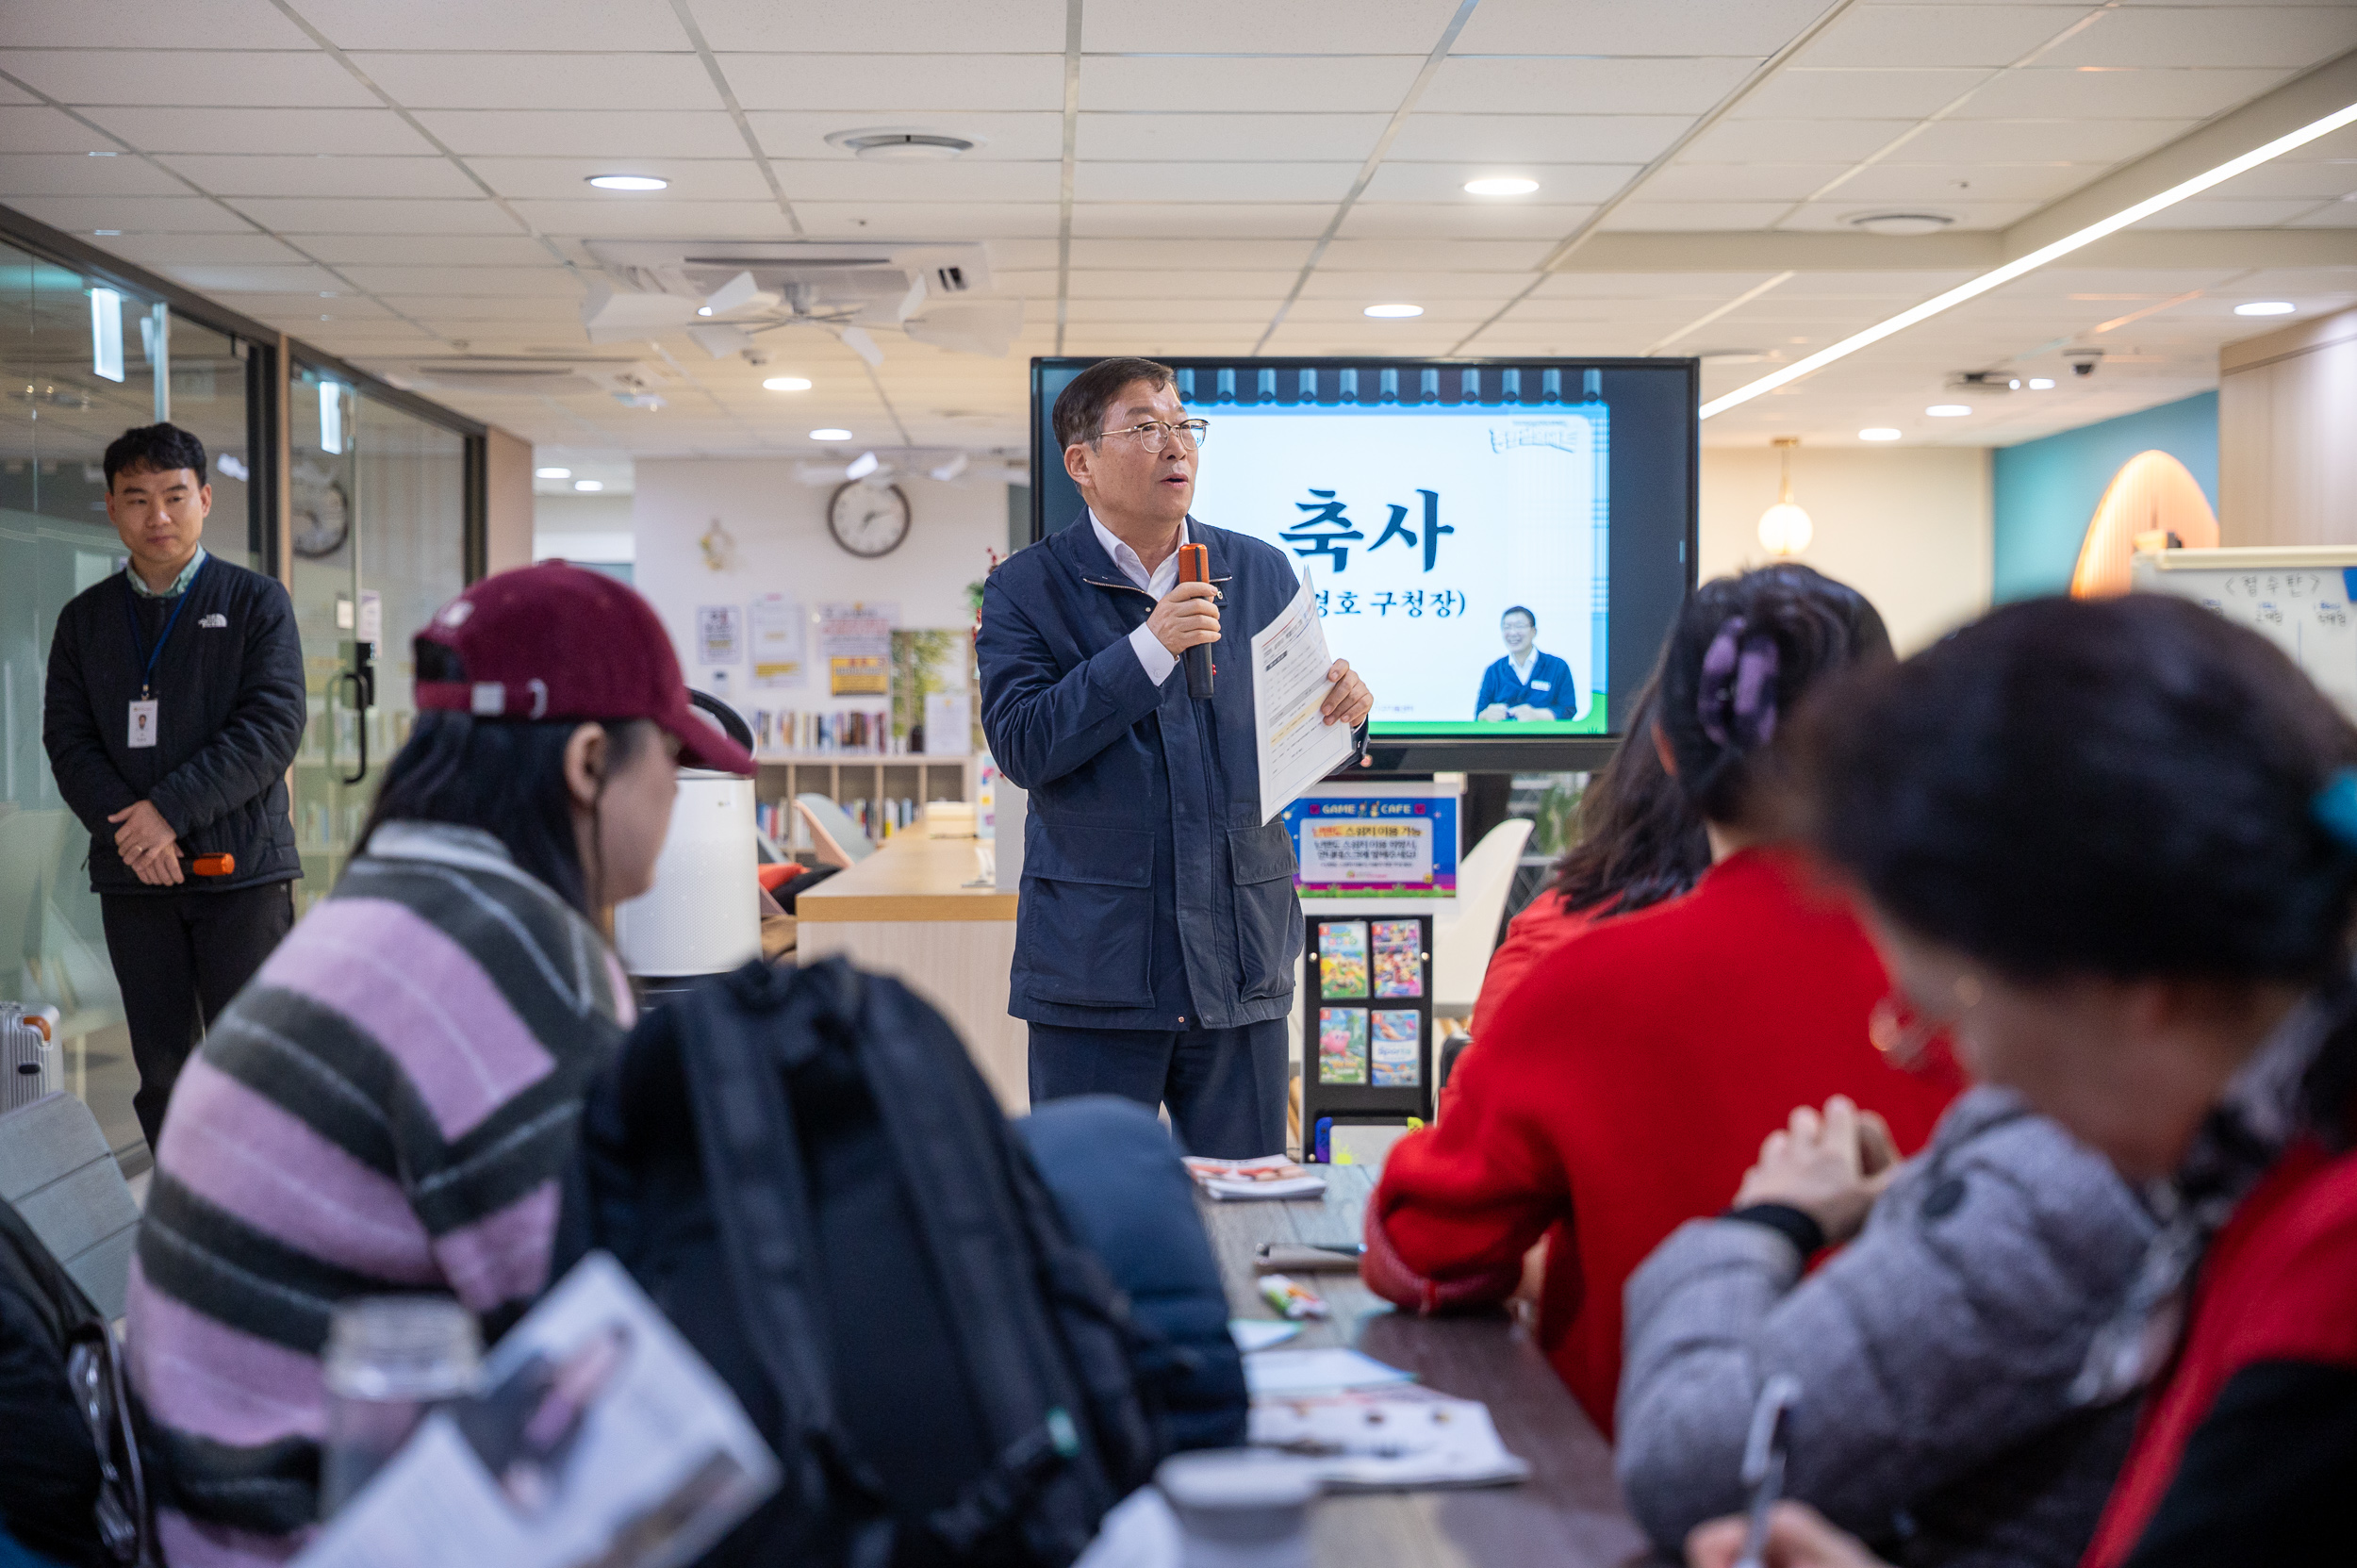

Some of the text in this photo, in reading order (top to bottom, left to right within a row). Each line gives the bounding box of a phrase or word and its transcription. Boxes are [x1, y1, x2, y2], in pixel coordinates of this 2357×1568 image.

[1278, 488, 1455, 572] 축사
[1370, 590, 1466, 618] 구청장)
[1322, 803, 1412, 815] GAME CAFE
[1345, 825, 1376, 836] 스위치
[1377, 826, 1398, 836] 이용
[1403, 826, 1422, 836] 가능
[1343, 840, 1368, 850] 스위치
